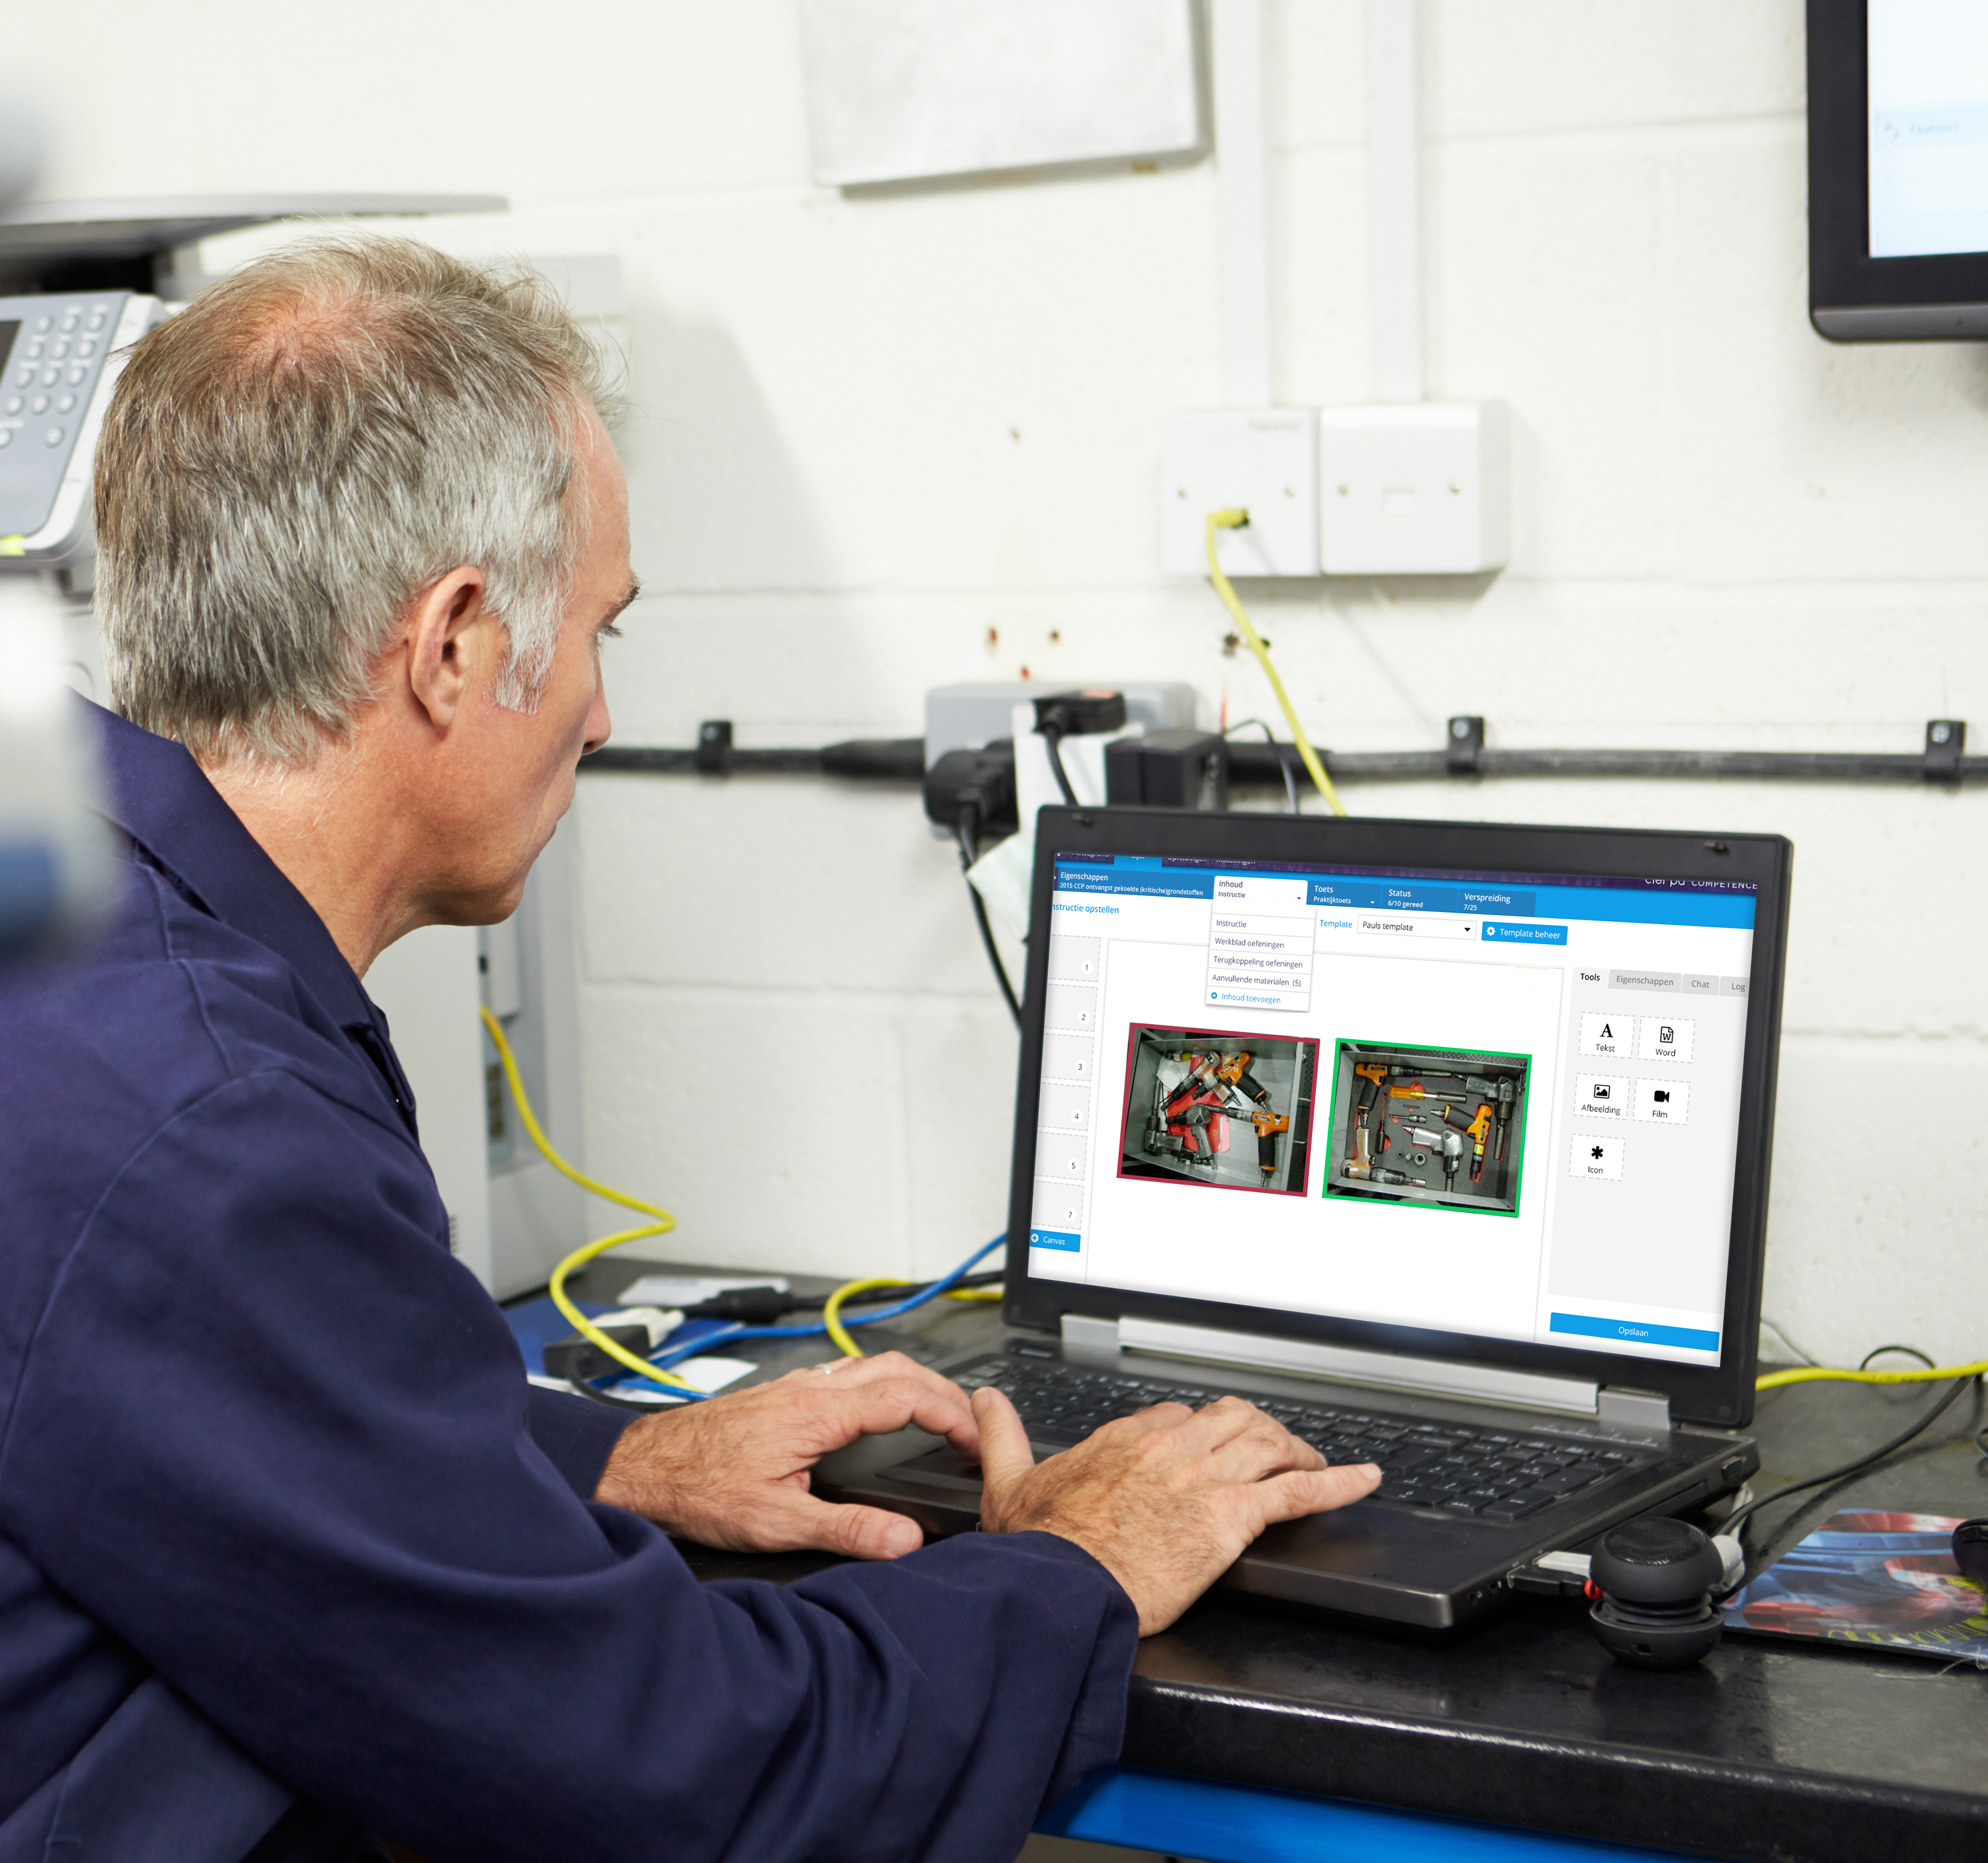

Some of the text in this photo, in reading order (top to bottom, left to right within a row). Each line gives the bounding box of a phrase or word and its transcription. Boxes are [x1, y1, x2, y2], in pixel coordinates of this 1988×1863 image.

[1061, 872, 1108, 881] Eigenschappen
[1139, 887, 1203, 897] (kritische)grondstoffen
[1314, 896, 1351, 904] Praktijktoets
[1464, 893, 1511, 905] Verspreiding
[1086, 906, 1119, 914] opstellen
[1320, 920, 1352, 929] Template
[1500, 929, 1560, 938] Template beheer
[1215, 938, 1284, 950] Werkblad oefeningen
[1214, 956, 1302, 969] Terugkoppeling oefeningen
[1212, 974, 1252, 983] Aanvullende
[1617, 976, 1673, 986] Eigenschappen
[1732, 983, 1745, 992] Log
[1247, 996, 1280, 1005] toevoegen
[1596, 1044, 1614, 1052] Tekst
[1581, 1104, 1620, 1116] Afbeelding
[1043, 1236, 1065, 1245] Canvas
[1619, 1327, 1648, 1336] Opslaan
